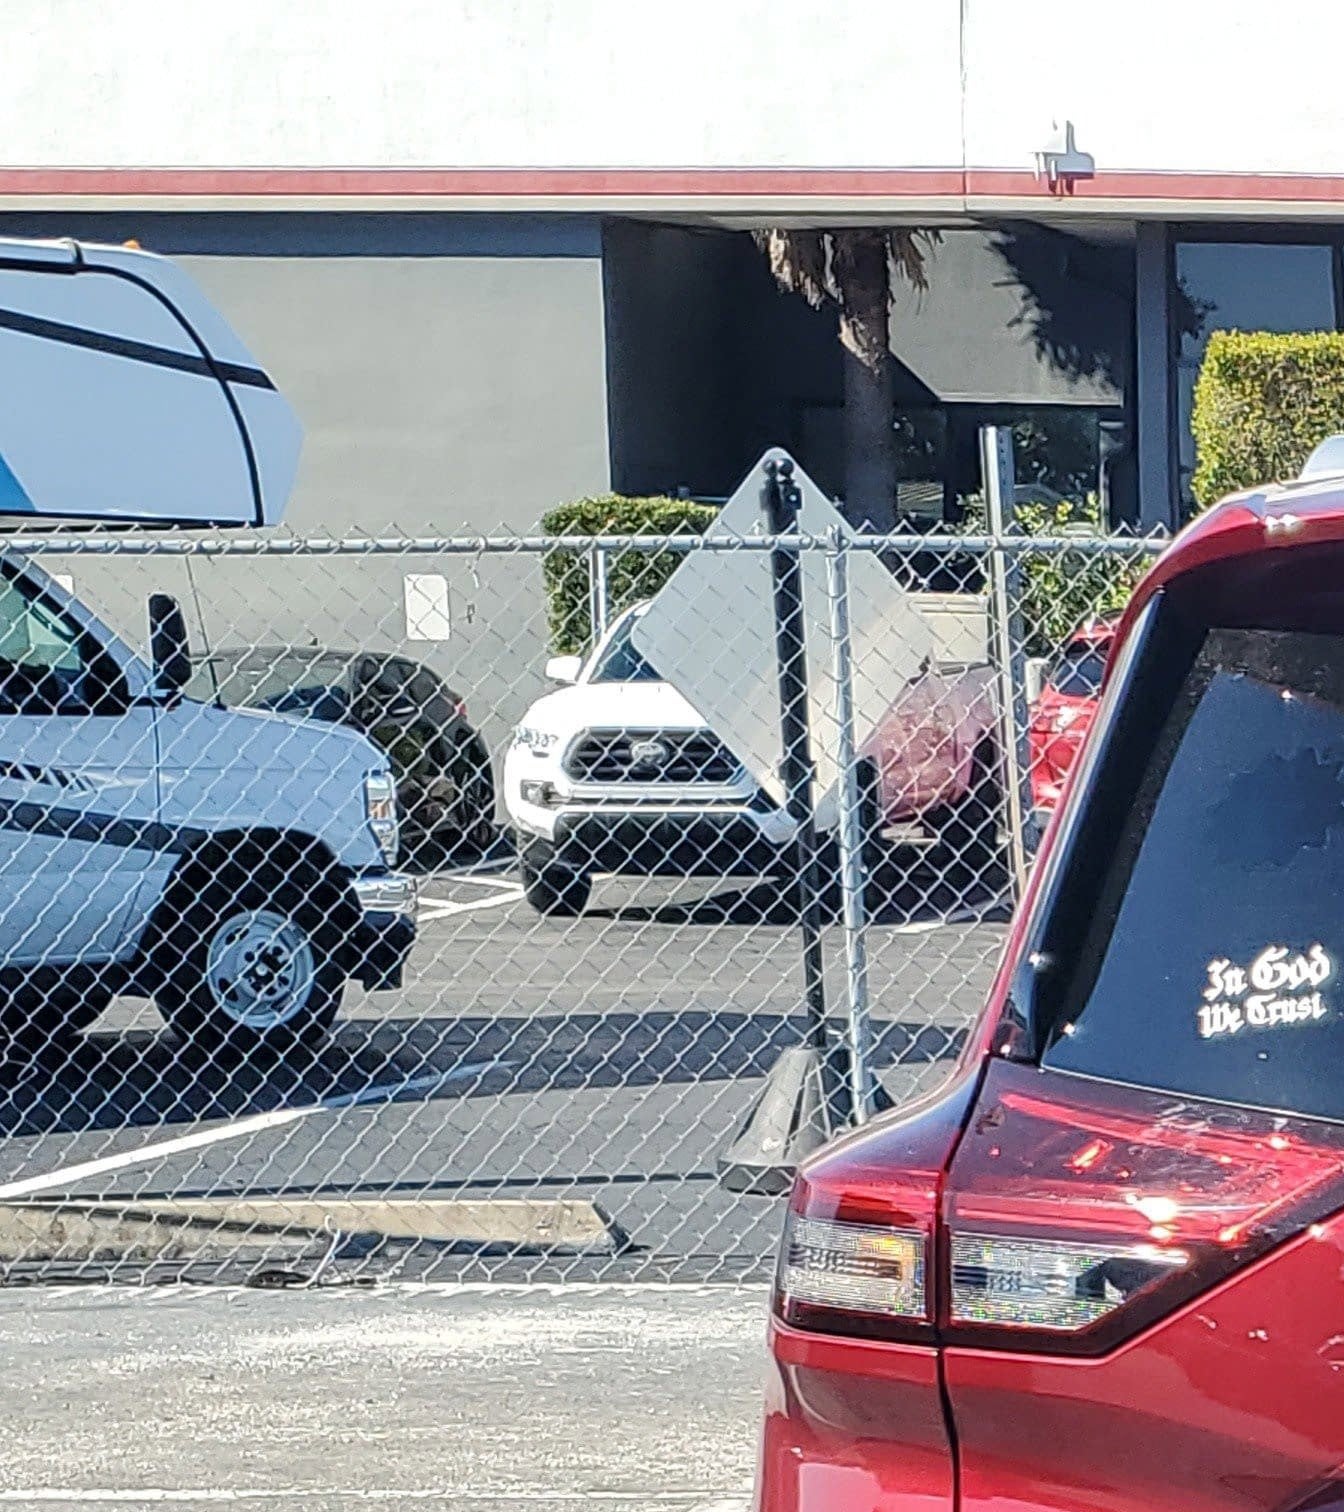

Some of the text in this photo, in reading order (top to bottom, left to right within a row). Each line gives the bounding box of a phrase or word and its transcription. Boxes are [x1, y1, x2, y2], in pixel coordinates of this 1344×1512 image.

[1203, 943, 1331, 1001] In God
[1197, 992, 1327, 1038] We Trust
